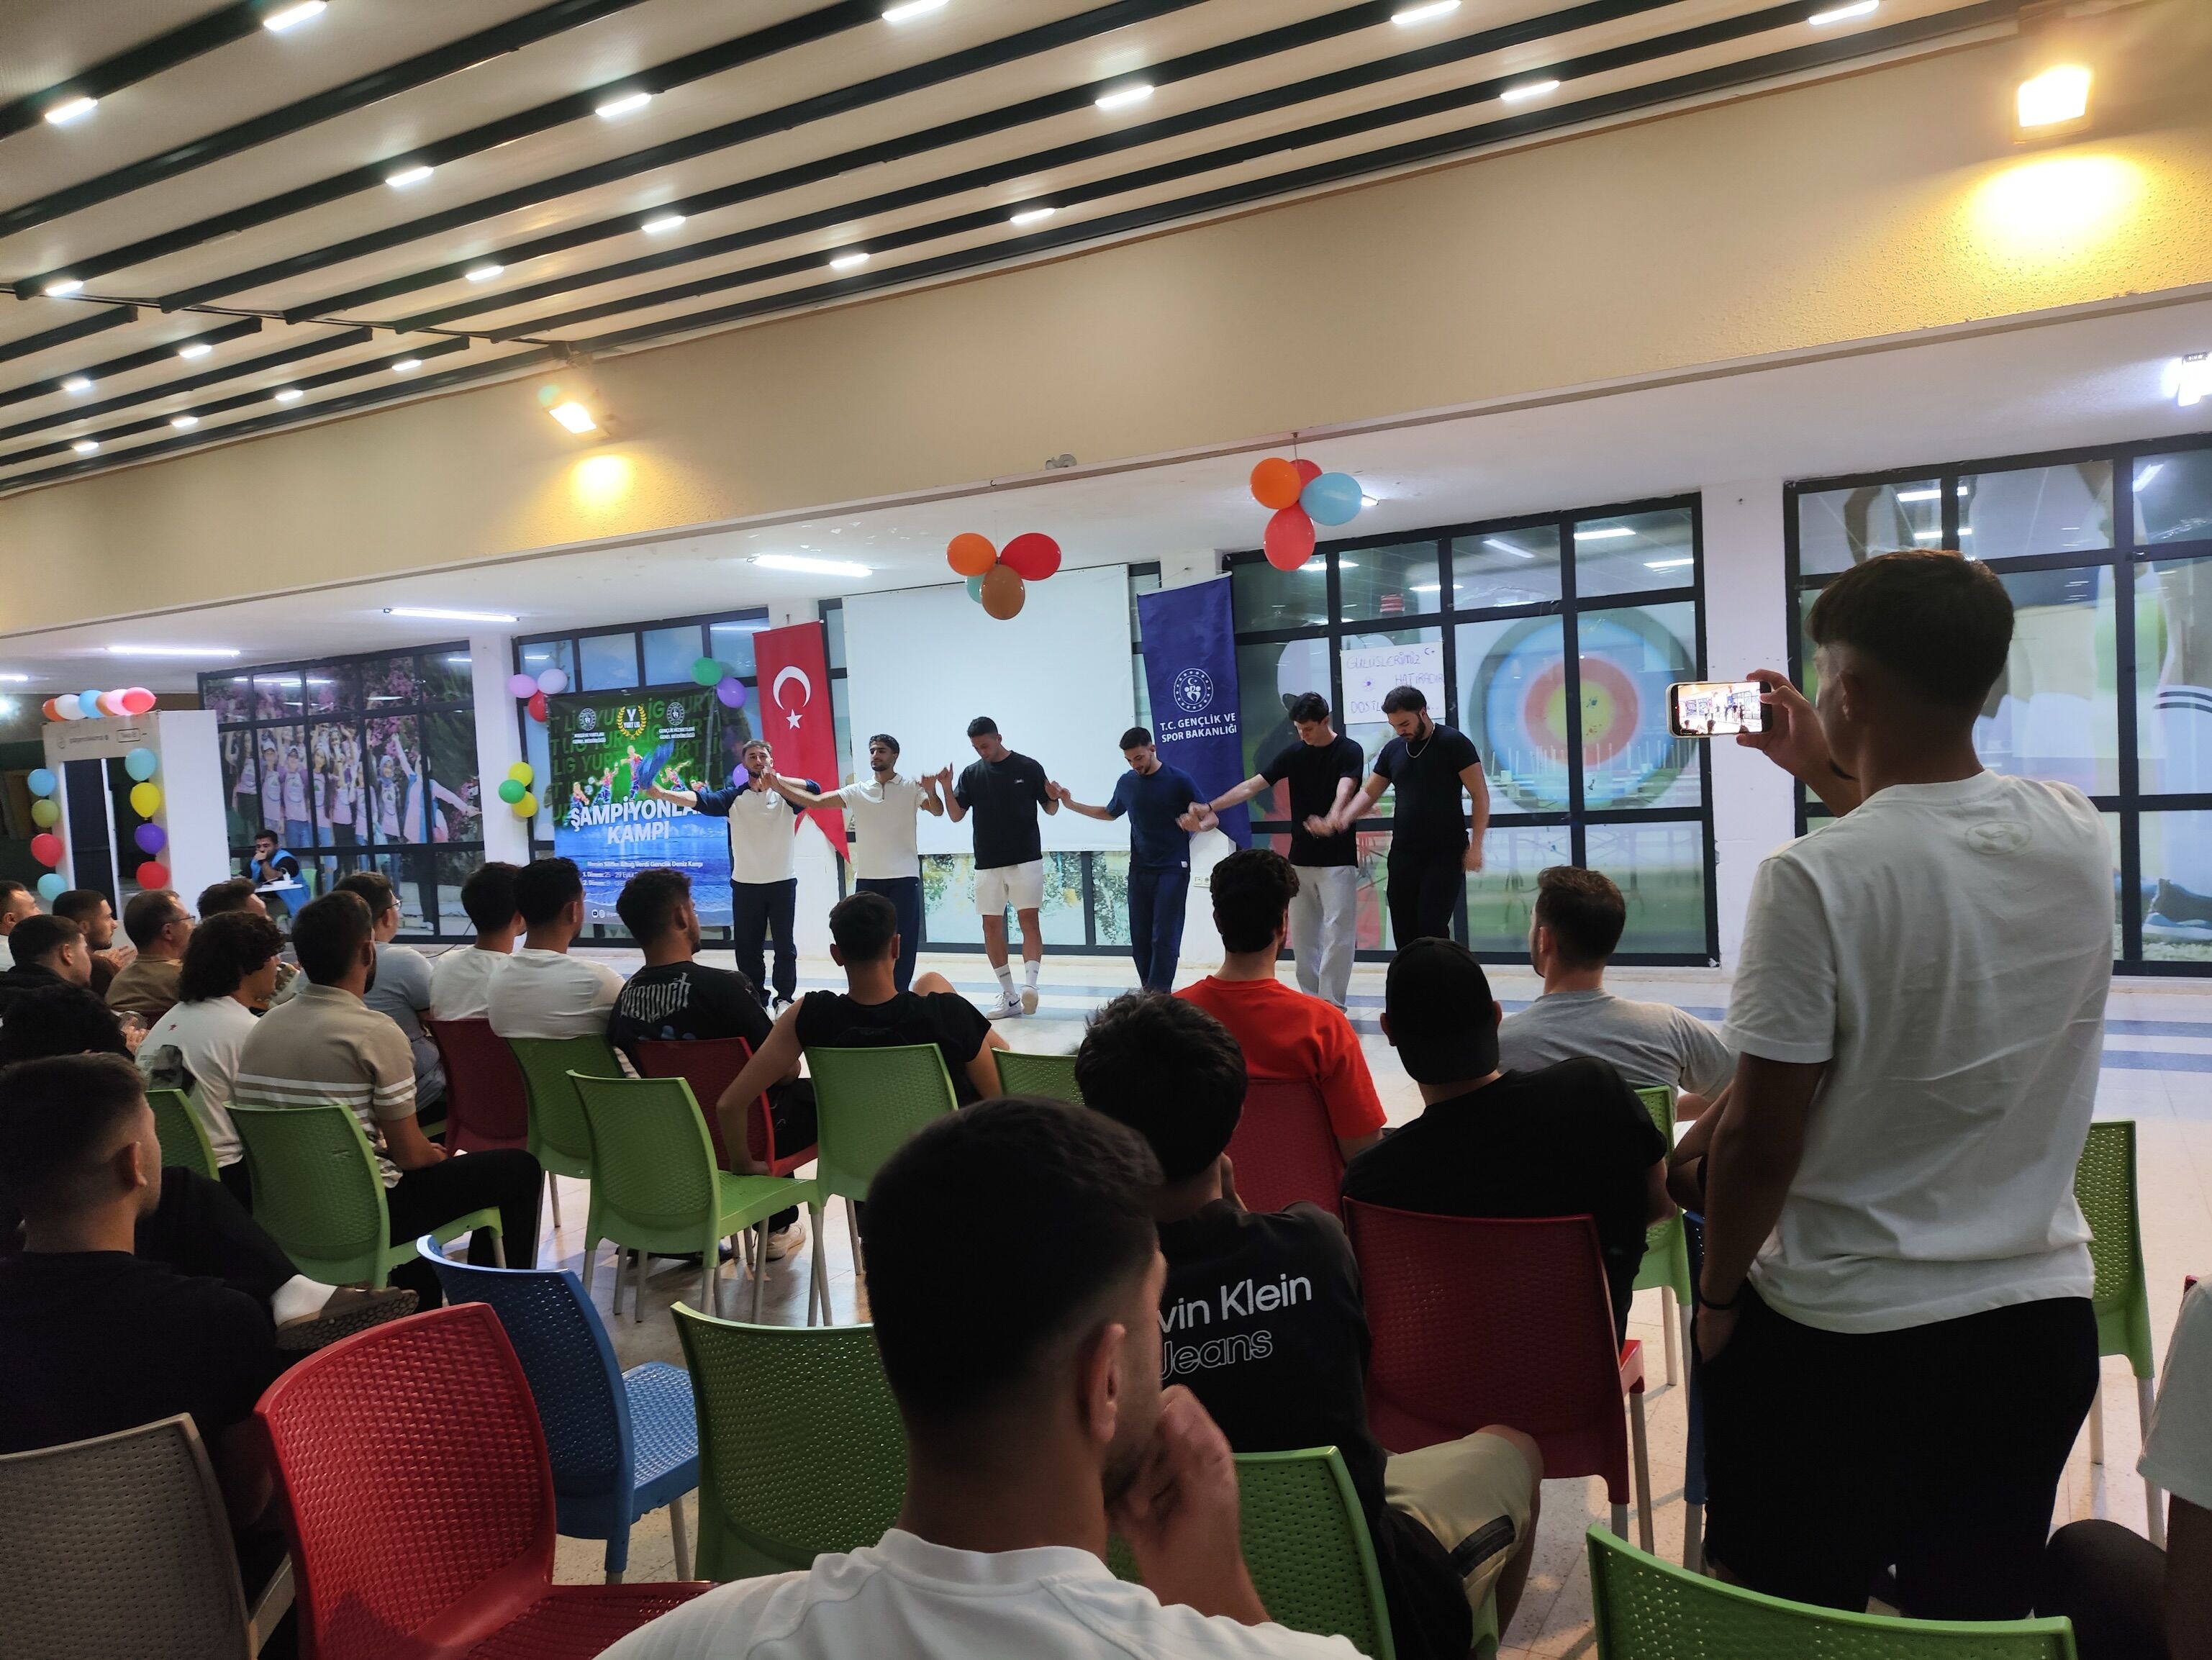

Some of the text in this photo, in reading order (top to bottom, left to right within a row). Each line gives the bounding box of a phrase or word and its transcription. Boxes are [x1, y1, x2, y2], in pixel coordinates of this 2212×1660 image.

[1160, 713, 1236, 731] T.C. GENÇLİK VE
[1161, 724, 1237, 743] SPOR BAKANLIĞI
[607, 820, 670, 845] KAMPI
[1157, 1273, 1312, 1333] vin Klein
[1159, 1330, 1273, 1380] Jeans
